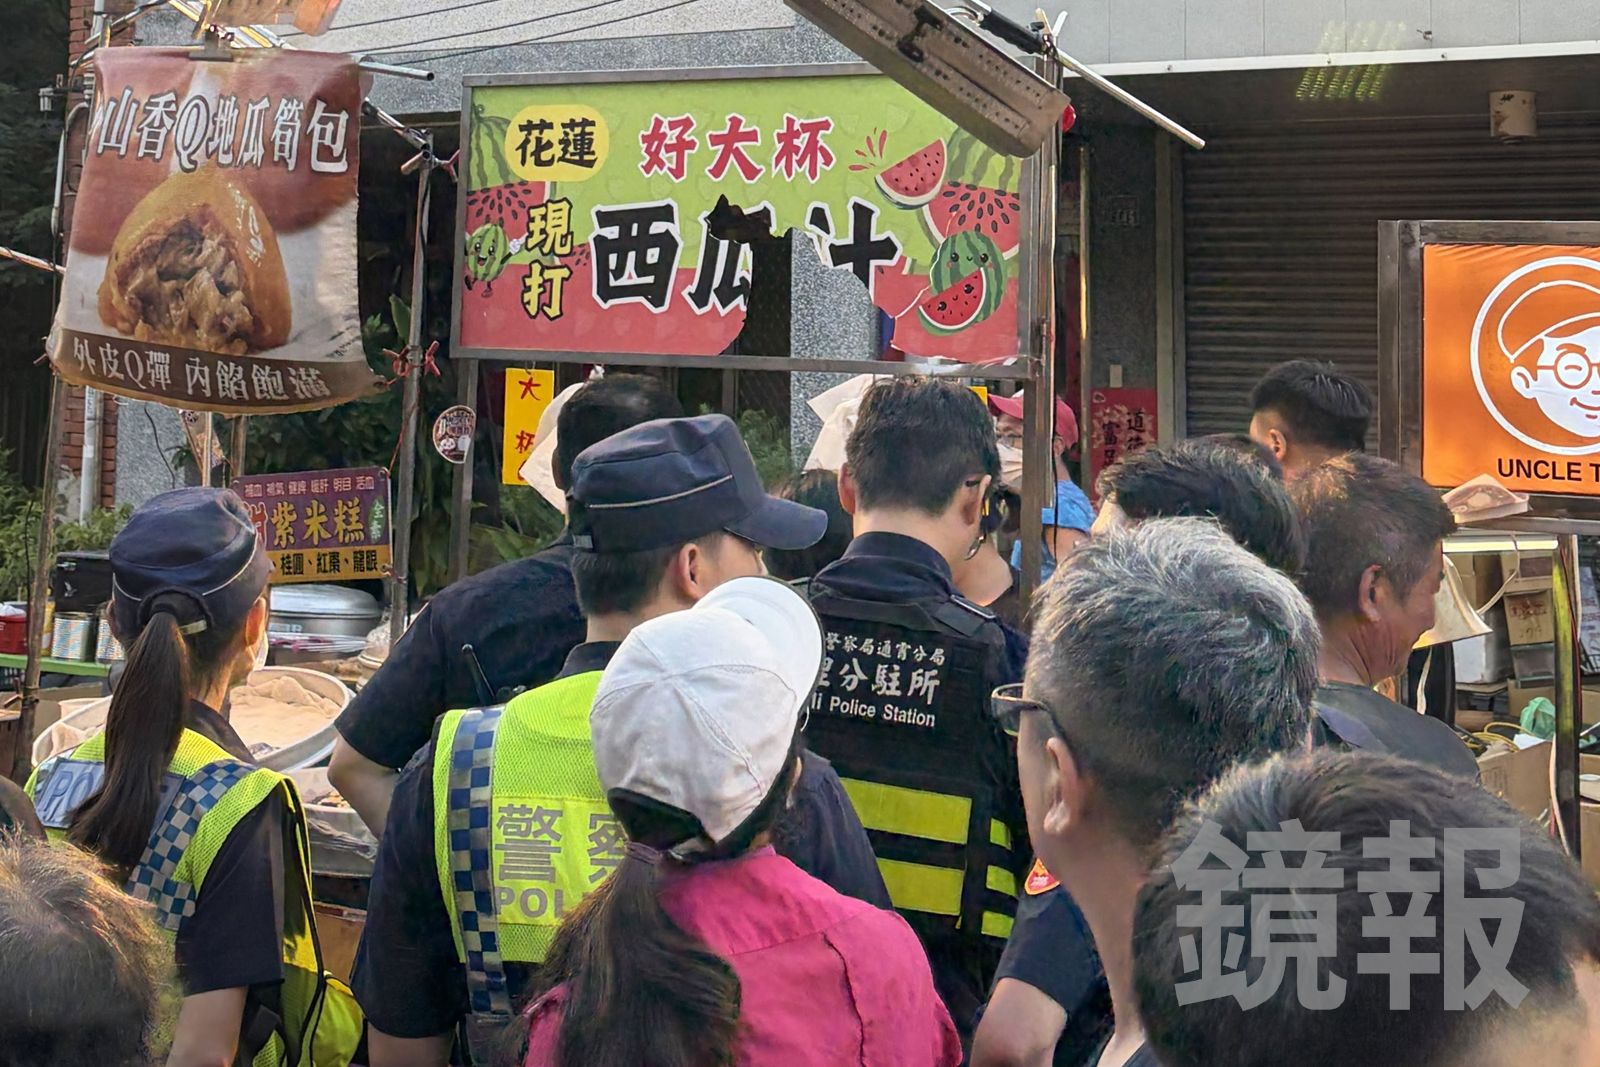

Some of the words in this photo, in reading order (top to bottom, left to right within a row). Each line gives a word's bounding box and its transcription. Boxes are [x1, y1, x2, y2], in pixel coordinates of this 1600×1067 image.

[96, 86, 350, 173] 山香Q地瓜筍包
[515, 117, 598, 169] 花蓮
[639, 113, 836, 183] 好大杯
[520, 197, 574, 320] 現打
[73, 336, 172, 391] 外皮Q彈
[185, 356, 332, 401] 內餡飽滿
[1497, 458, 1582, 482] UNCLE
[270, 496, 365, 549] 紫米糕
[829, 696, 876, 718] Police
[883, 703, 936, 728] Station
[494, 803, 628, 884] 警察
[494, 886, 590, 919] POL
